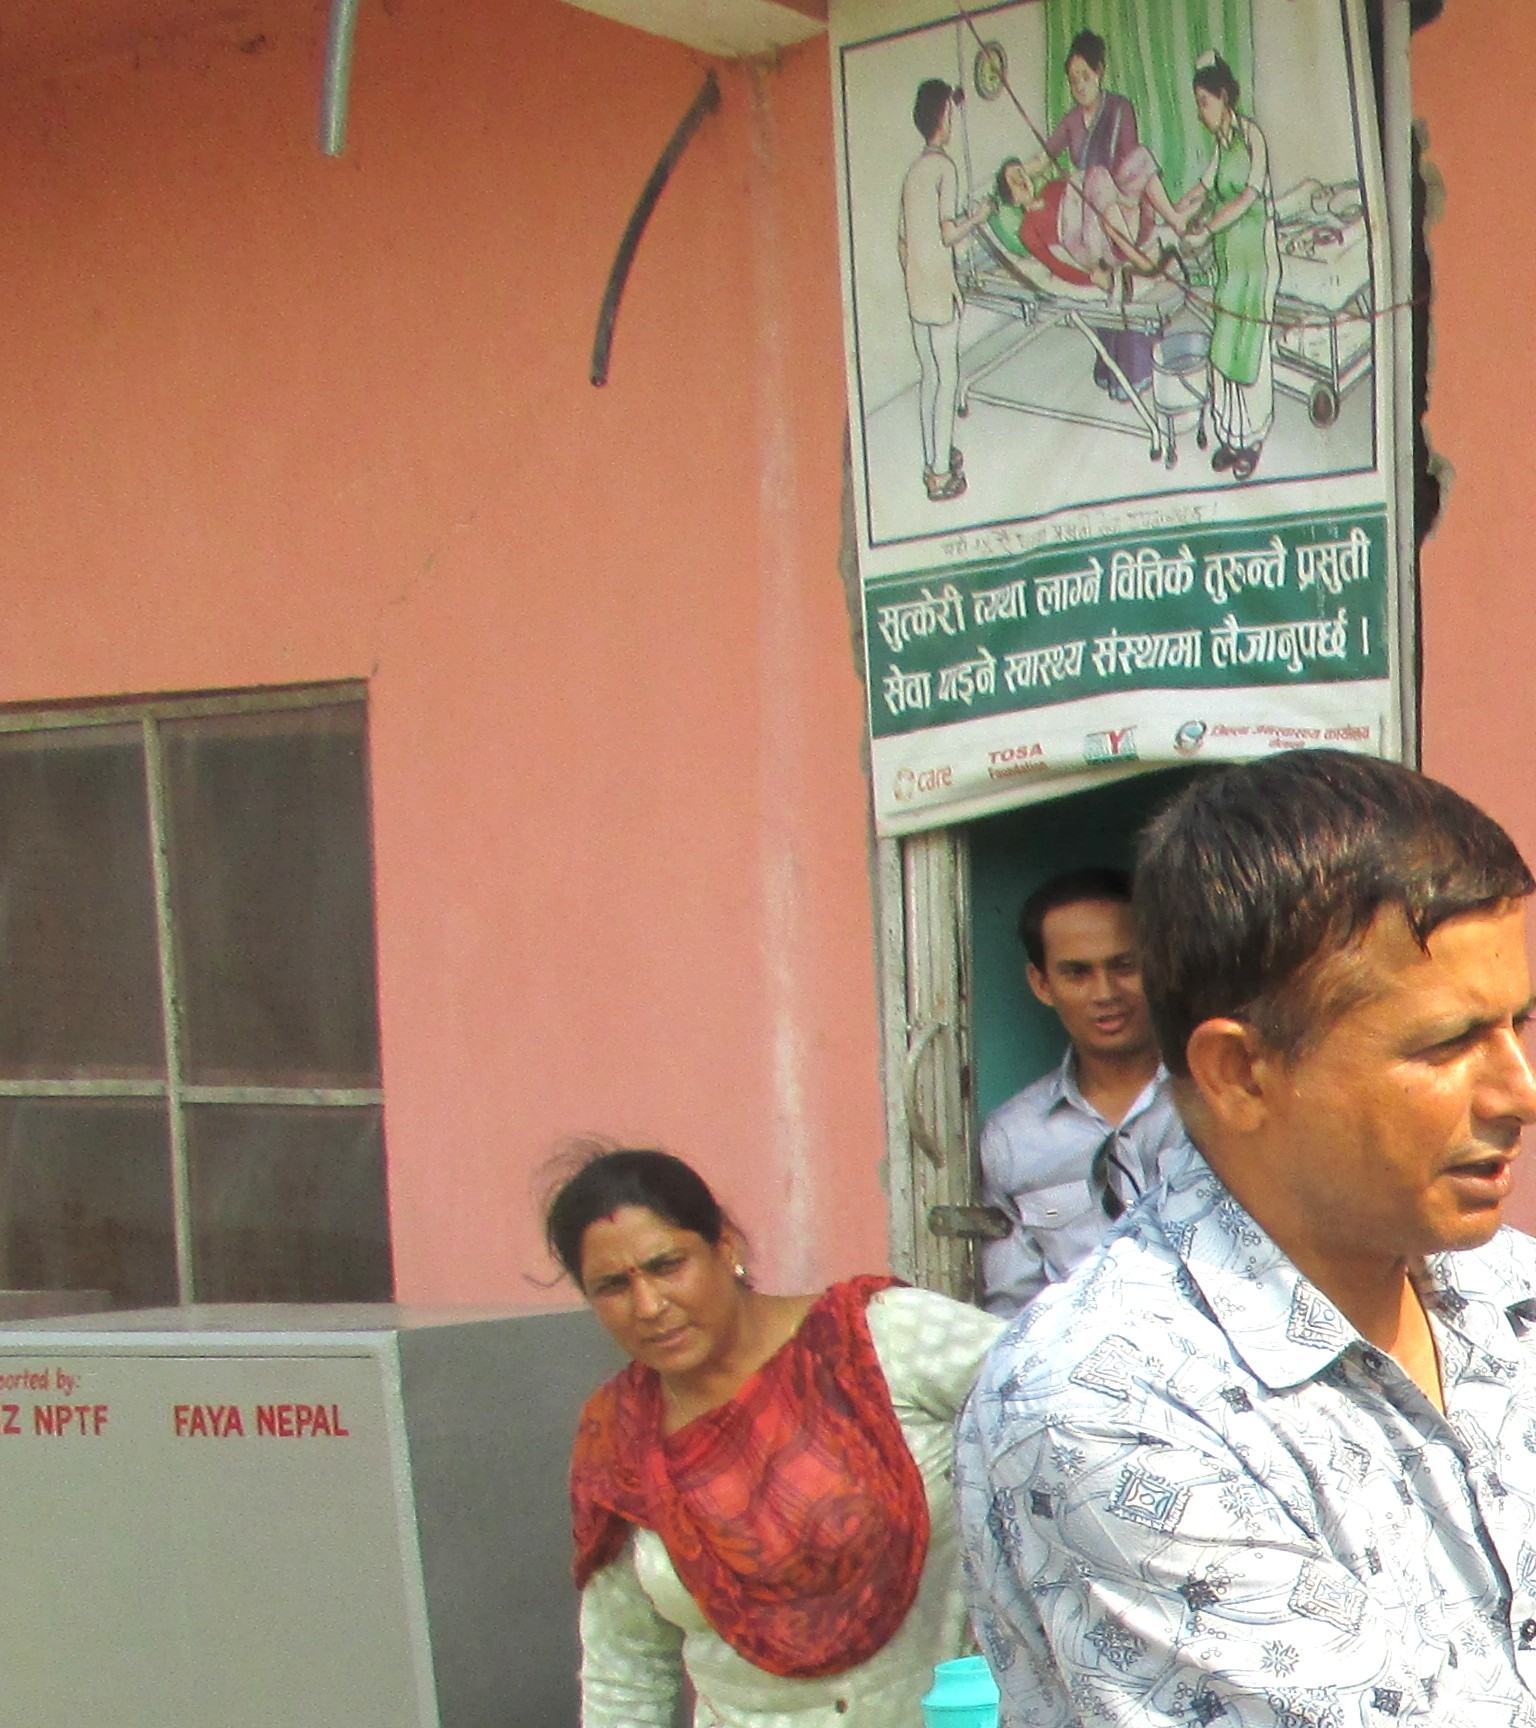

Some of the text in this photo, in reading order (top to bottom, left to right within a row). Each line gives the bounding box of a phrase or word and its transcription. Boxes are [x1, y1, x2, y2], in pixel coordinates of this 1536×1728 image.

[883, 664, 932, 716] सेवा
[1092, 628, 1202, 677] संस्थामा
[988, 743, 1044, 764] TOSA
[0, 1367, 49, 1390] orted
[34, 1404, 108, 1436] NPTF
[174, 1404, 349, 1437] FAYA NEPAL
